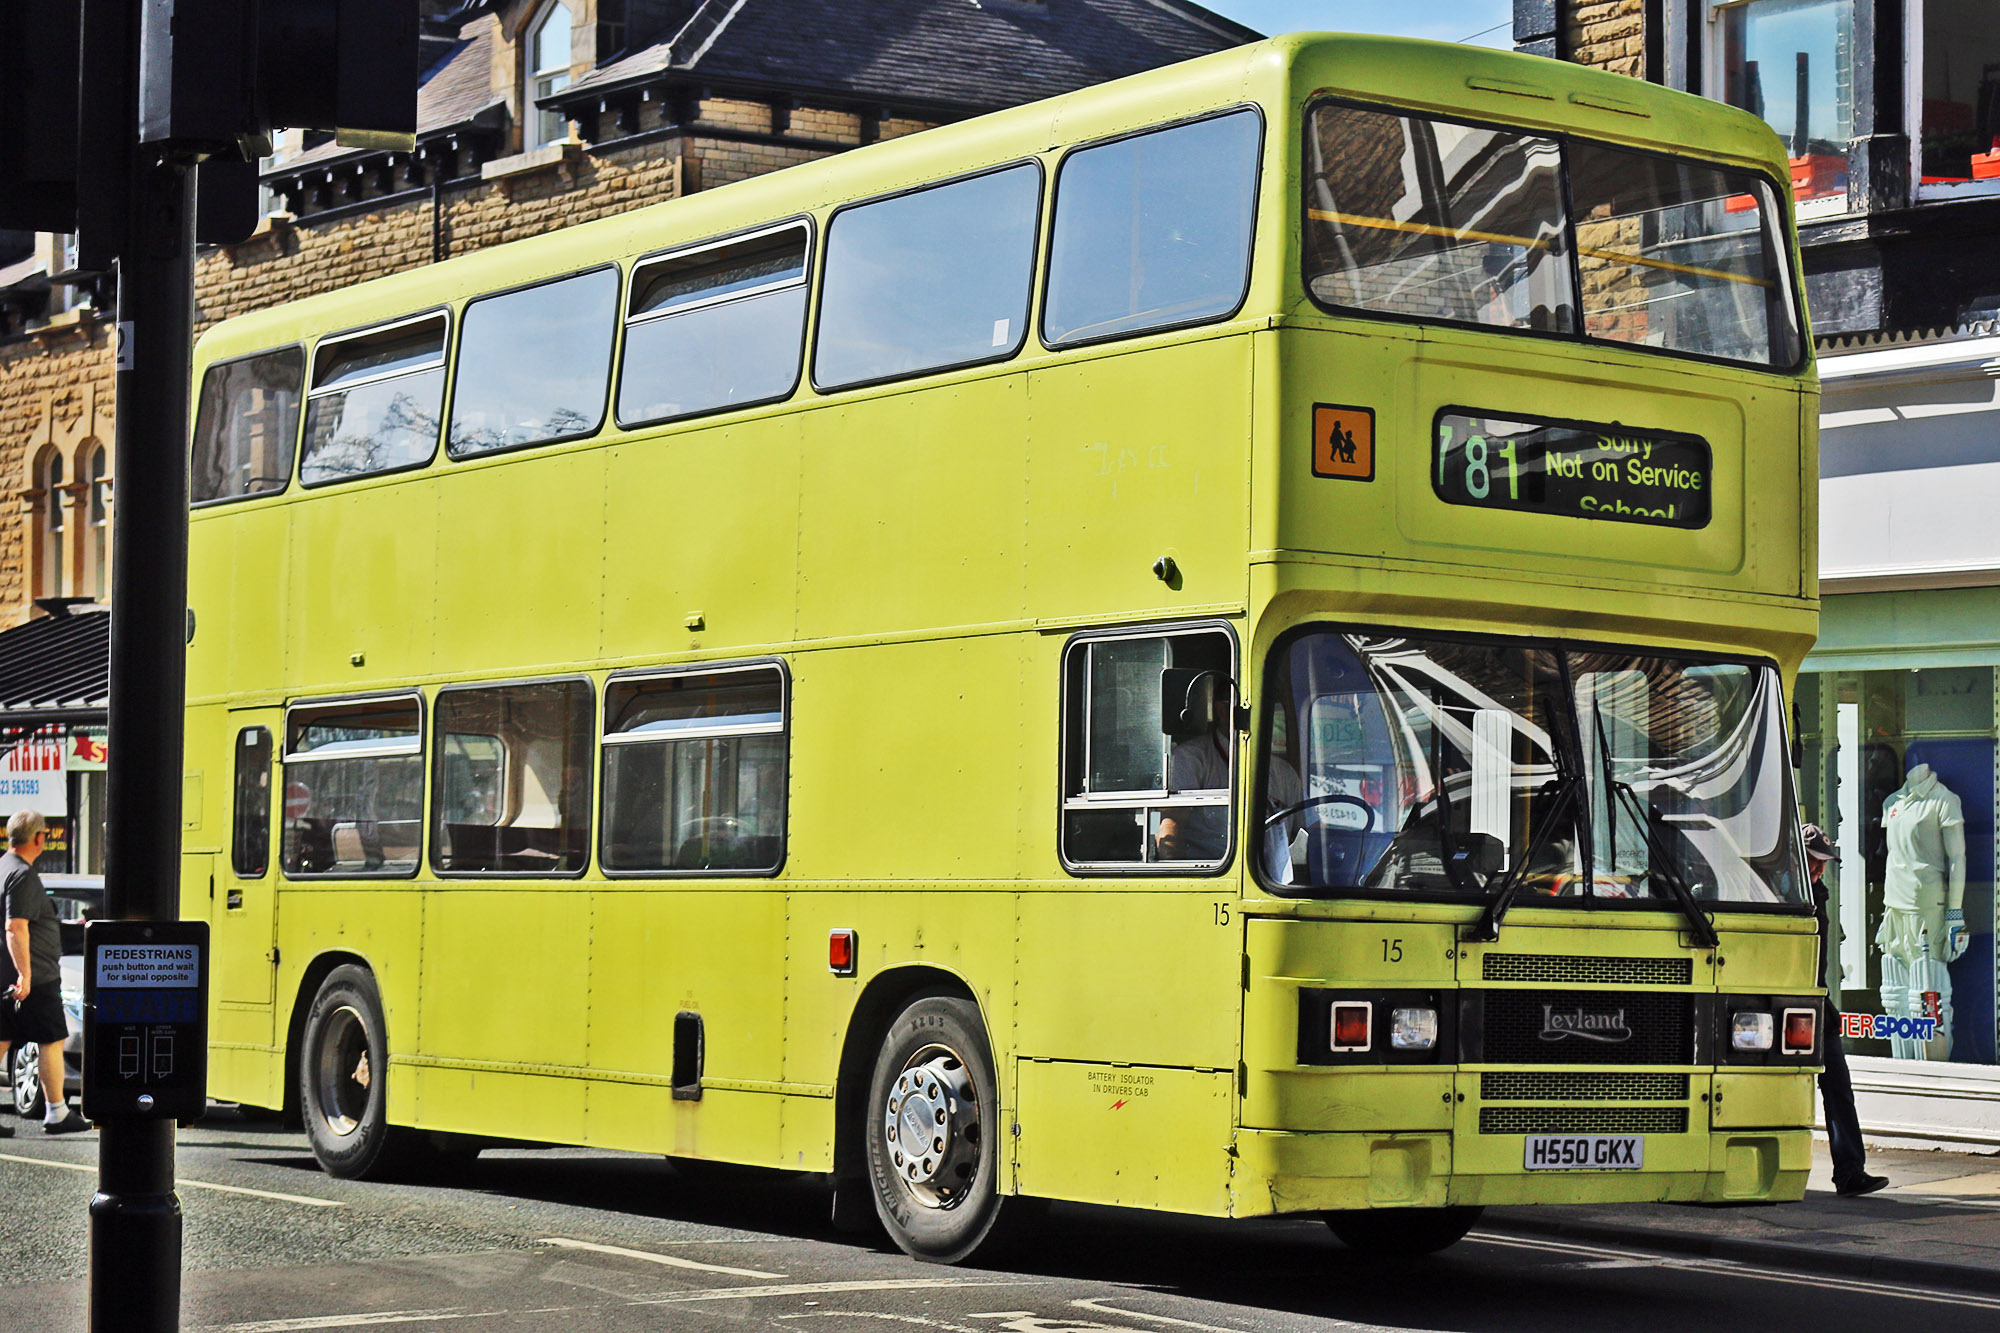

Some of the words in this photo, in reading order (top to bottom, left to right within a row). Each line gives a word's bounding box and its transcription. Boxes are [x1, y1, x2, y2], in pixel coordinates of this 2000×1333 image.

[1545, 451, 1584, 479] Not
[1592, 462, 1619, 482] on
[1627, 458, 1702, 490] Service
[90, 741, 108, 763] S
[0, 779, 9, 795] 23
[1213, 902, 1230, 927] 15
[104, 949, 193, 960] PEDESTRIANS
[1381, 938, 1403, 963] 15
[102, 963, 125, 973] push
[126, 963, 156, 971] button
[157, 963, 174, 971] and
[176, 963, 195, 971] wait
[107, 973, 120, 981] for
[121, 973, 149, 983] signal
[150, 973, 189, 983] opposite
[103, 994, 191, 1019] WAIT
[1540, 1005, 1631, 1041] Leyland
[1840, 1014, 1935, 1040] TERSPORT
[1087, 1071, 1117, 1082] BATTERY
[1120, 1074, 1155, 1086] ISOLATOR
[1093, 1084, 1101, 1093] IN
[1102, 1084, 1133, 1096] DRIVERS
[1134, 1087, 1149, 1097] CAB
[1533, 1139, 1589, 1165] H550
[1594, 1139, 1636, 1165] GKX
